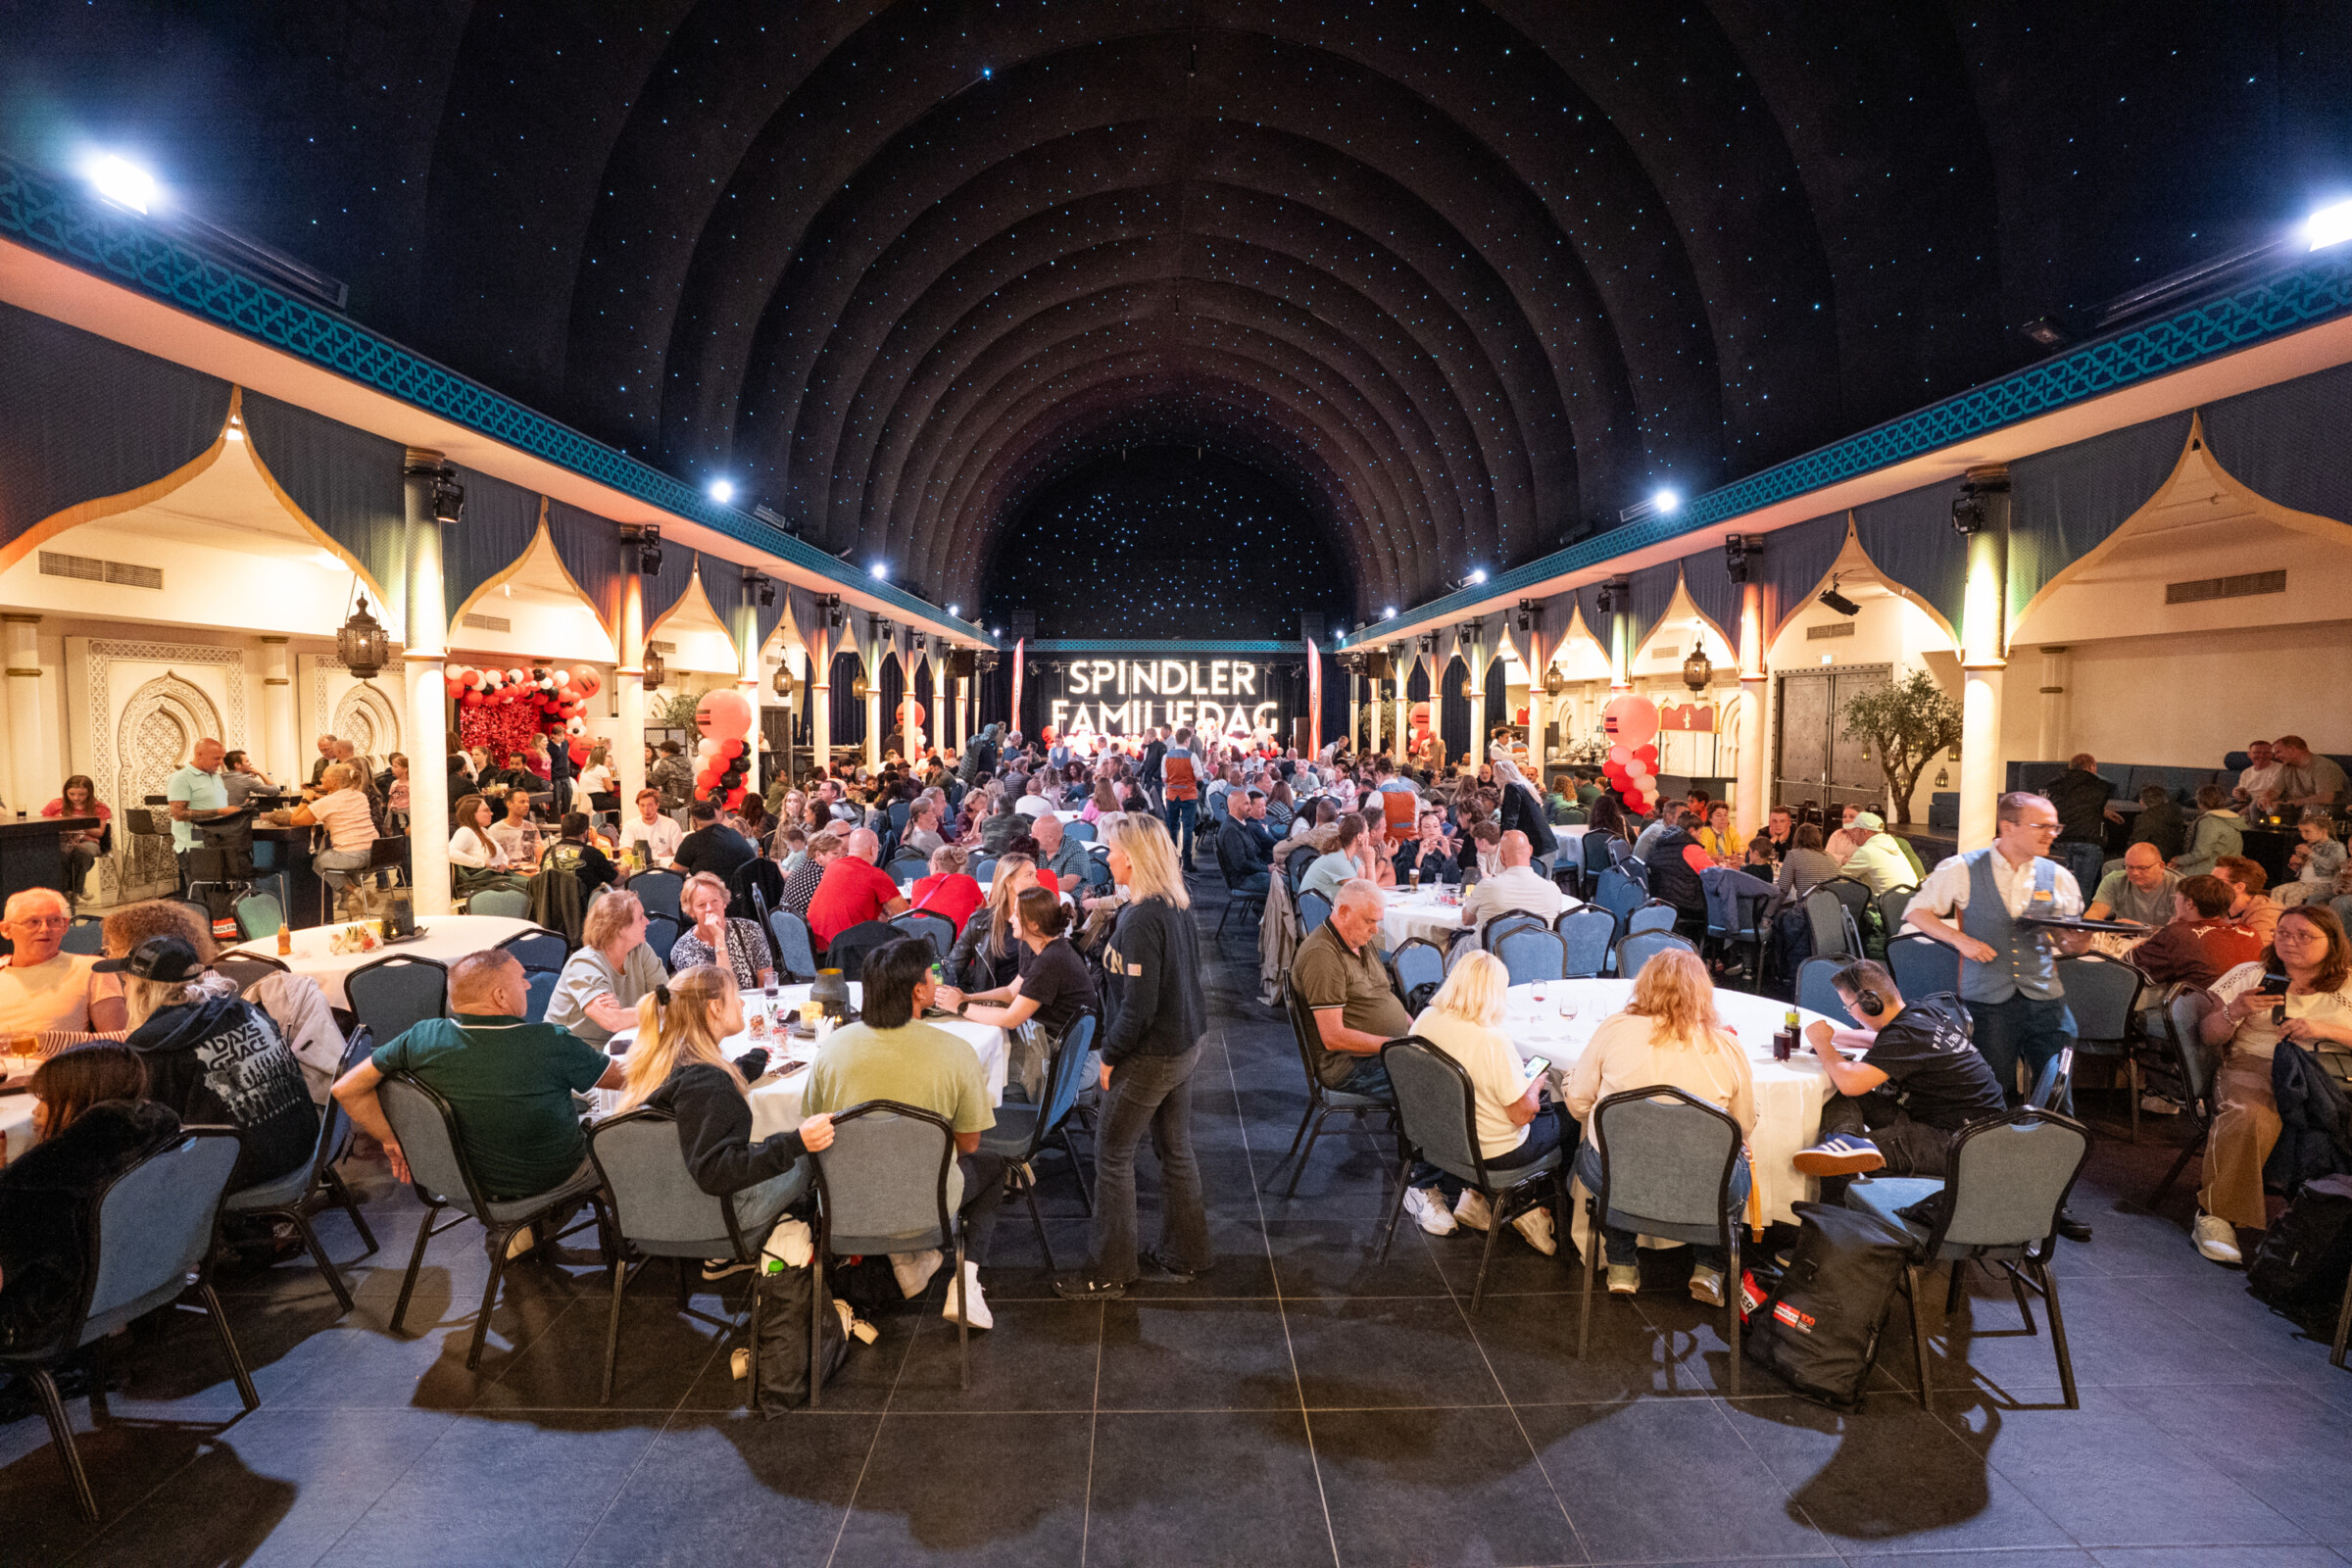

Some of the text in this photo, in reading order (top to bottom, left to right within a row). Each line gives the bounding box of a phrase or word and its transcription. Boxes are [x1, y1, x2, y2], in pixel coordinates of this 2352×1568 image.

[1068, 660, 1255, 695] SPINDLER
[1052, 700, 1278, 735] FAMILIEDAG
[209, 1036, 270, 1072] GRACE
